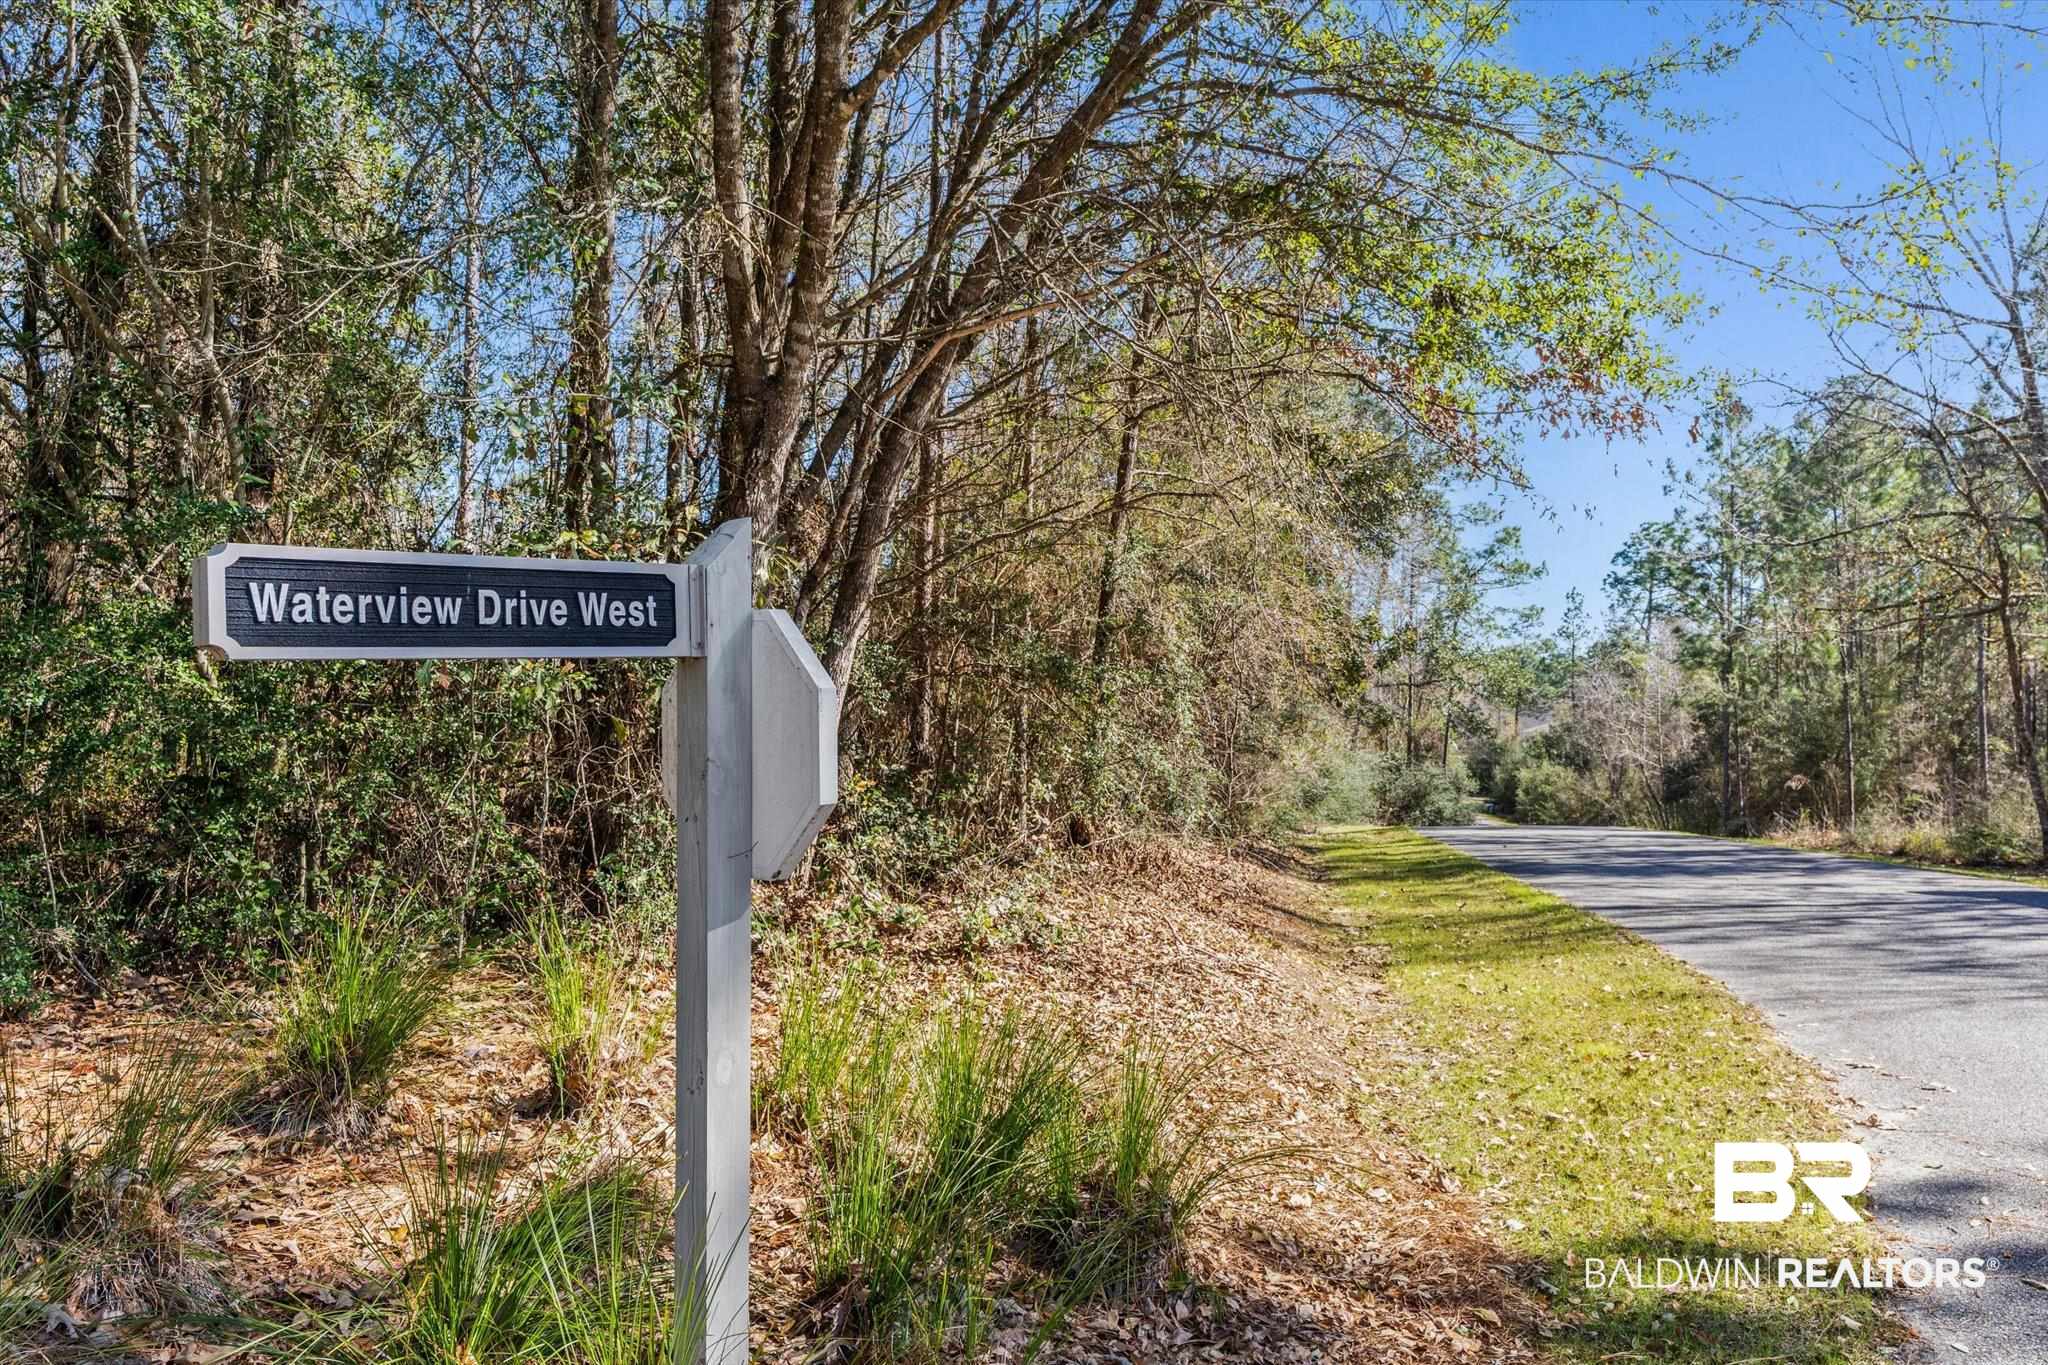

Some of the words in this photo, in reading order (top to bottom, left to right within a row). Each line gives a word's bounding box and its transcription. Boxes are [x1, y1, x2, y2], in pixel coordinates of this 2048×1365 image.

[248, 581, 463, 626] Waterview
[478, 588, 569, 627] Drive
[577, 590, 658, 628] West
